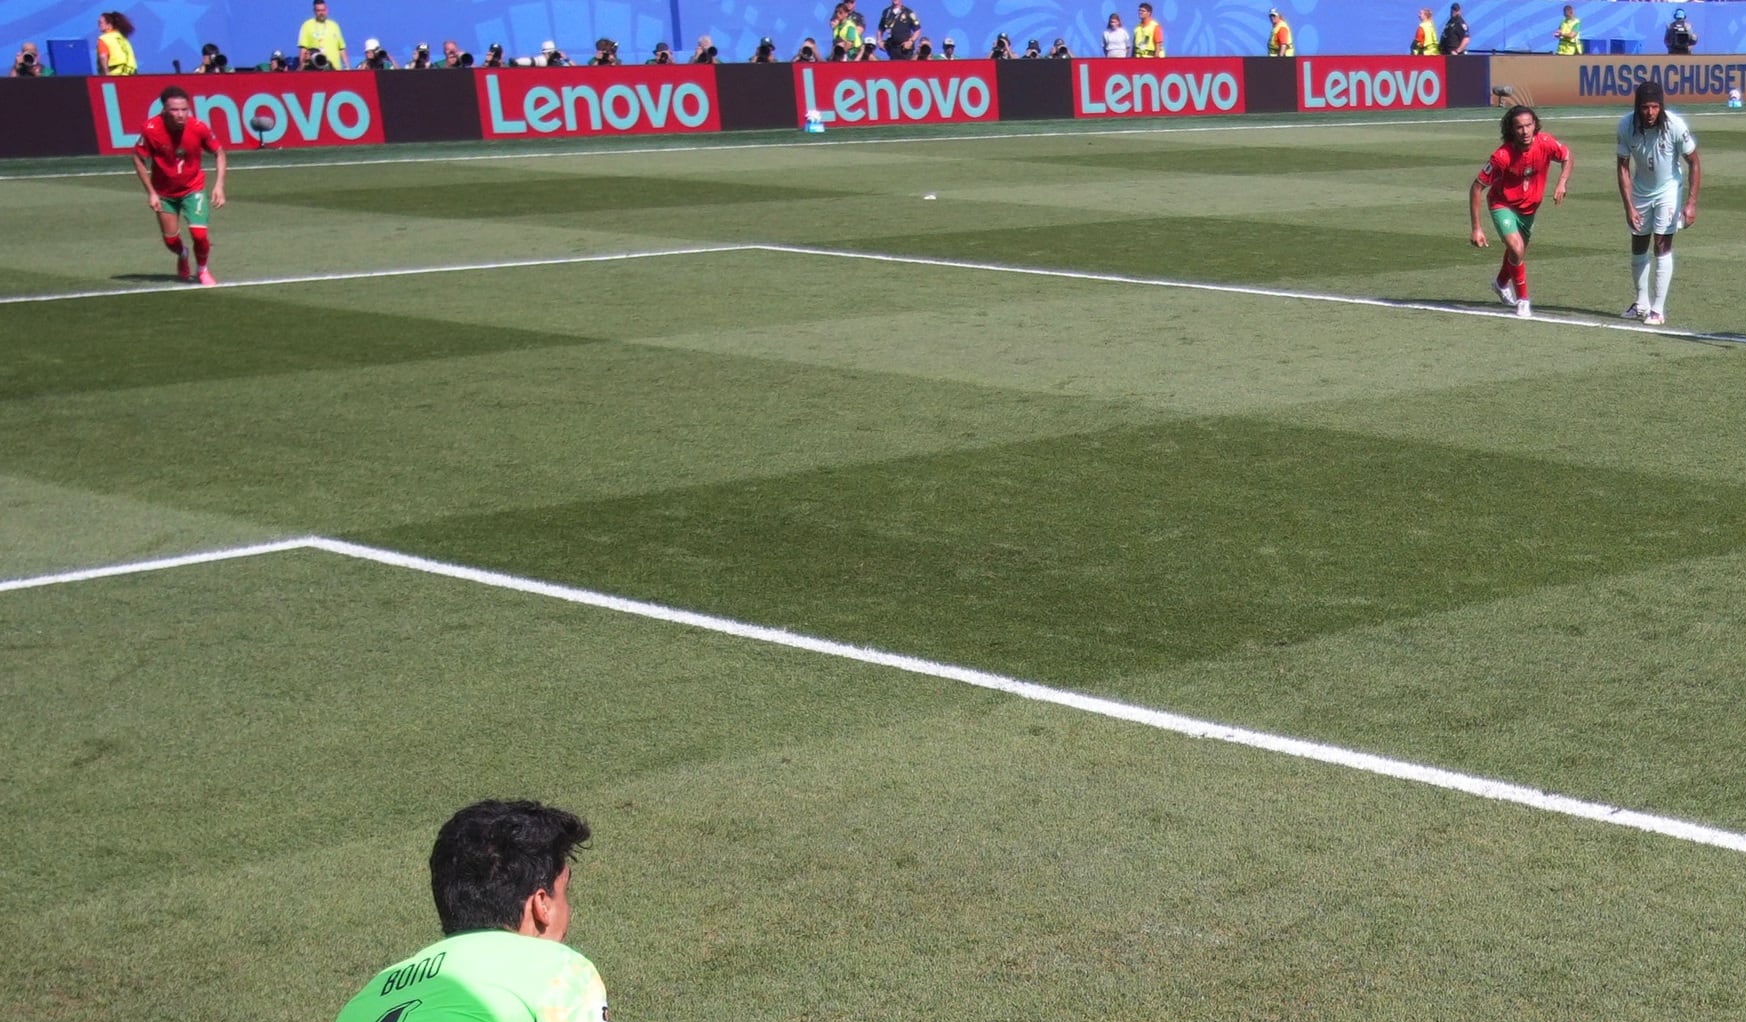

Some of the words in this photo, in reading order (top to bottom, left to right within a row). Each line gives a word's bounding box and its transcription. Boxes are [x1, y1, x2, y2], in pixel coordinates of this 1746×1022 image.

[486, 74, 710, 134] Lenovo
[803, 68, 990, 122] Lenovo
[1079, 64, 1238, 114] Lenovo
[1304, 61, 1441, 108] Lenovo
[195, 193, 204, 211] 7
[380, 952, 446, 996] BONO
